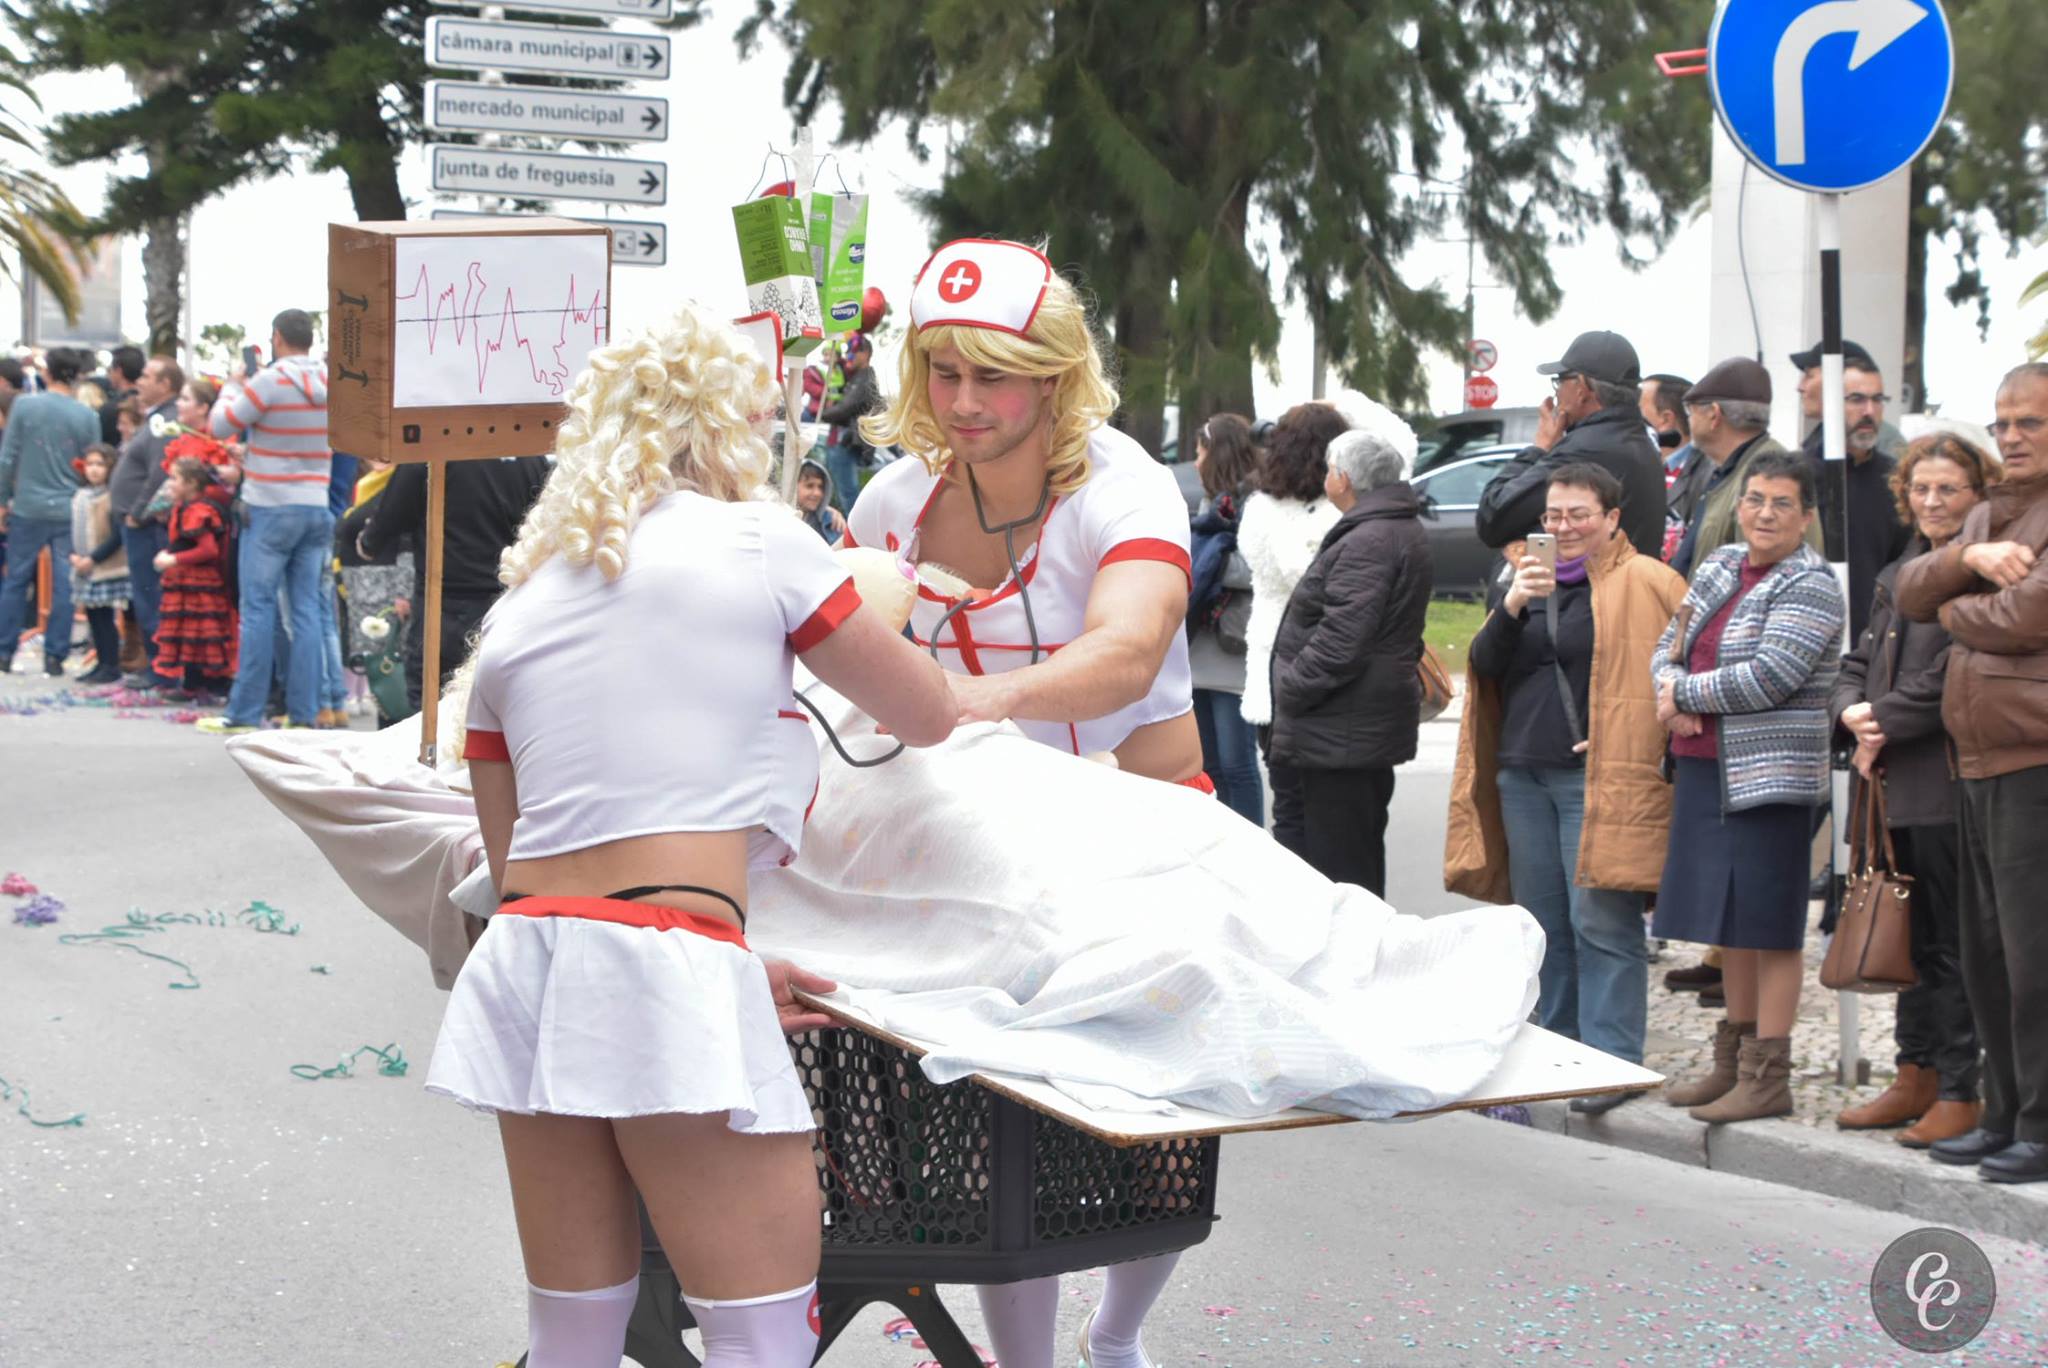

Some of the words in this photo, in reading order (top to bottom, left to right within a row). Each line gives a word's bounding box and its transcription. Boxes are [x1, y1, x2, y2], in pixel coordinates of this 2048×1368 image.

[440, 31, 513, 53] câmara
[520, 41, 614, 63] municipal
[439, 98, 524, 118] mercado
[532, 105, 624, 125] municipal
[439, 157, 489, 179] junta
[496, 162, 519, 180] de
[527, 163, 615, 188] freguesia
[831, 304, 858, 318] Mimosa
[1465, 384, 1498, 400] STOP
